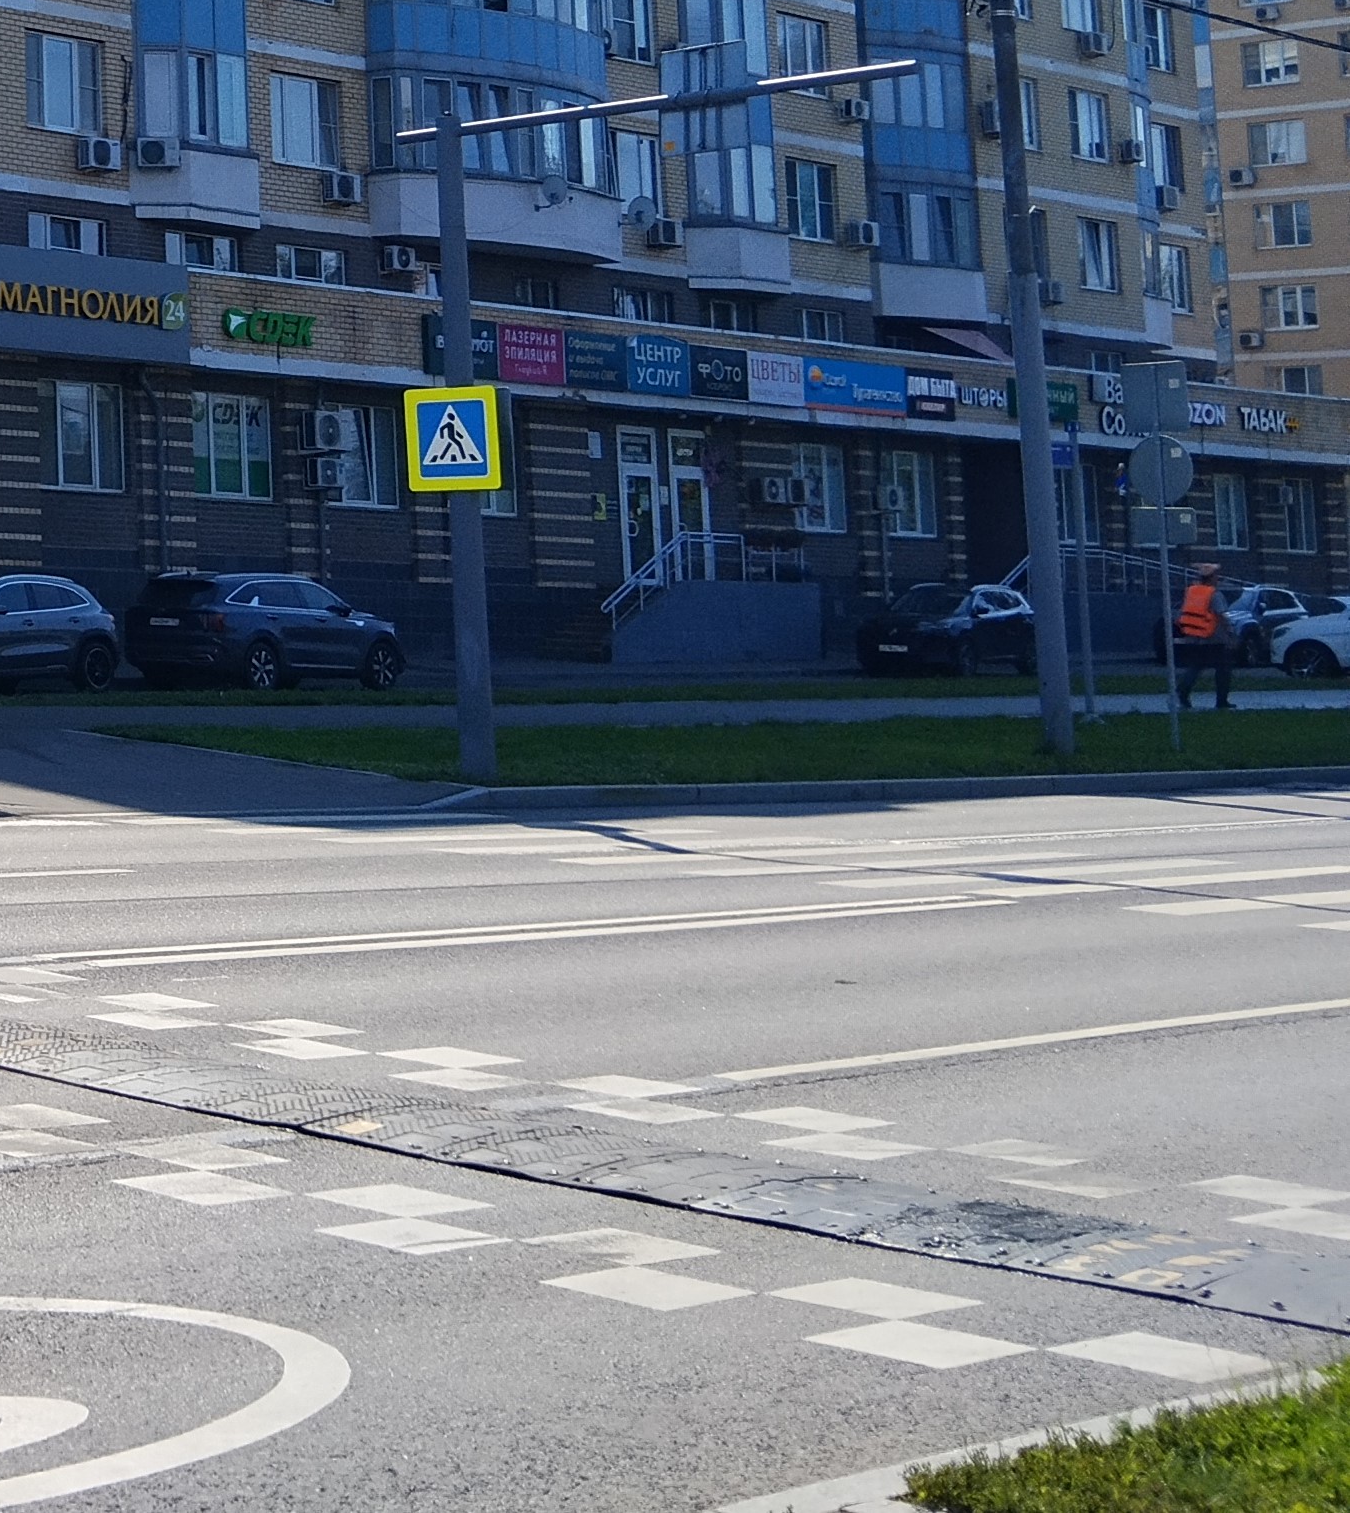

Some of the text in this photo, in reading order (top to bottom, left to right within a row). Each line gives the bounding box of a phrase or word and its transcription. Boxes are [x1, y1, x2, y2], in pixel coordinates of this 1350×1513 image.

[164, 298, 186, 323] 24
[504, 328, 557, 347] ЛАЗЕРНАЯ
[504, 345, 558, 364] ЭПИЛЯЦИЯ
[634, 342, 682, 364] ЦЕНТР
[636, 366, 682, 388] УСЛУГ
[697, 358, 742, 383] ФОТО
[750, 358, 802, 384] ЦВЕТЫ
[961, 386, 1008, 408] ШТОРЫ
[1240, 406, 1287, 434] ТАБАК
